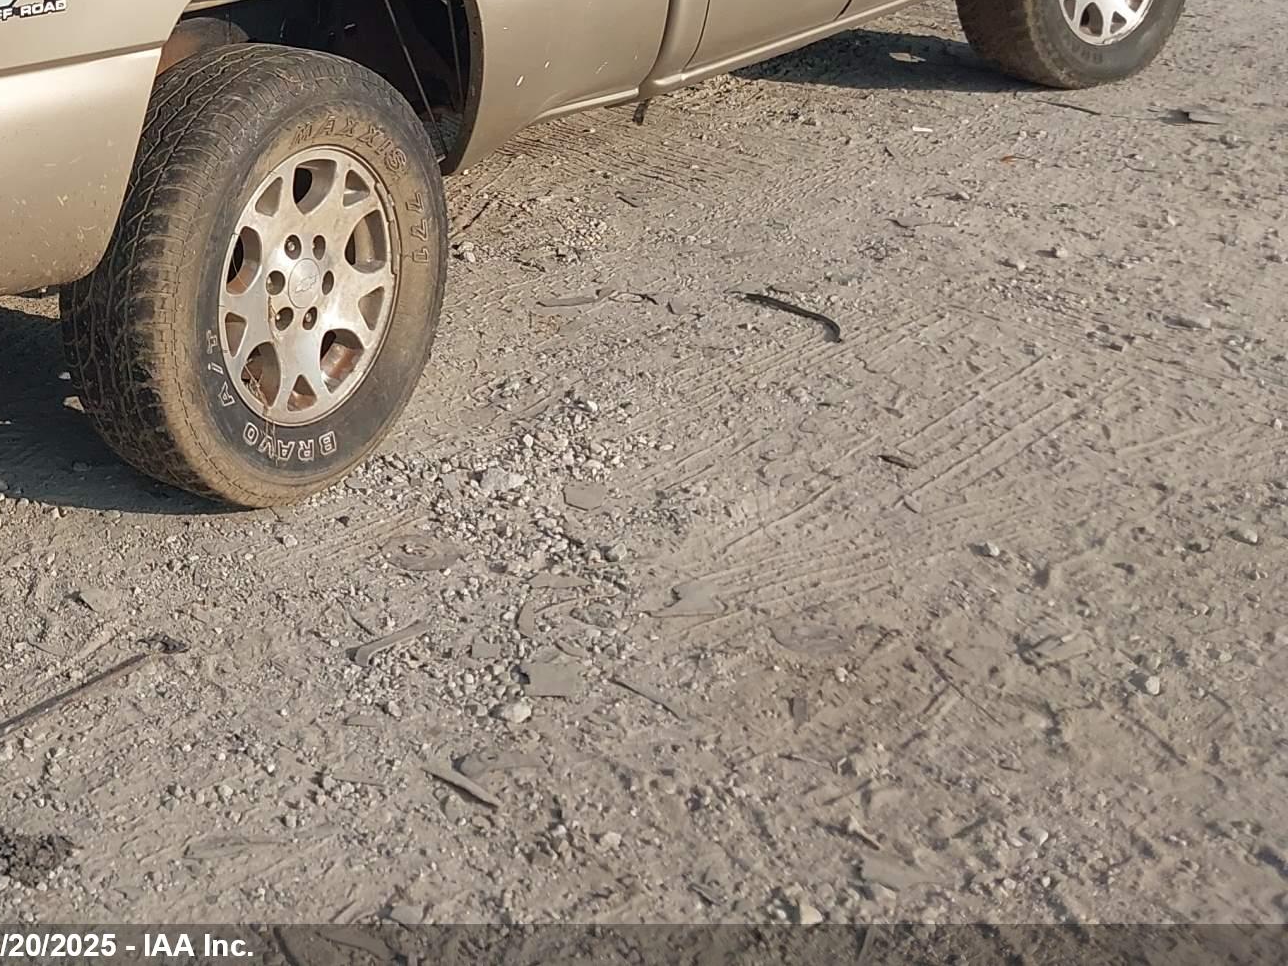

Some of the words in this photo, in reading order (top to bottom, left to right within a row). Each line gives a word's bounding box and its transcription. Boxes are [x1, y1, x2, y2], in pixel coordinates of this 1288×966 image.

[19, 0, 68, 18] ROAD
[288, 114, 407, 171] MAXXIS
[243, 422, 337, 461] BRAVO
